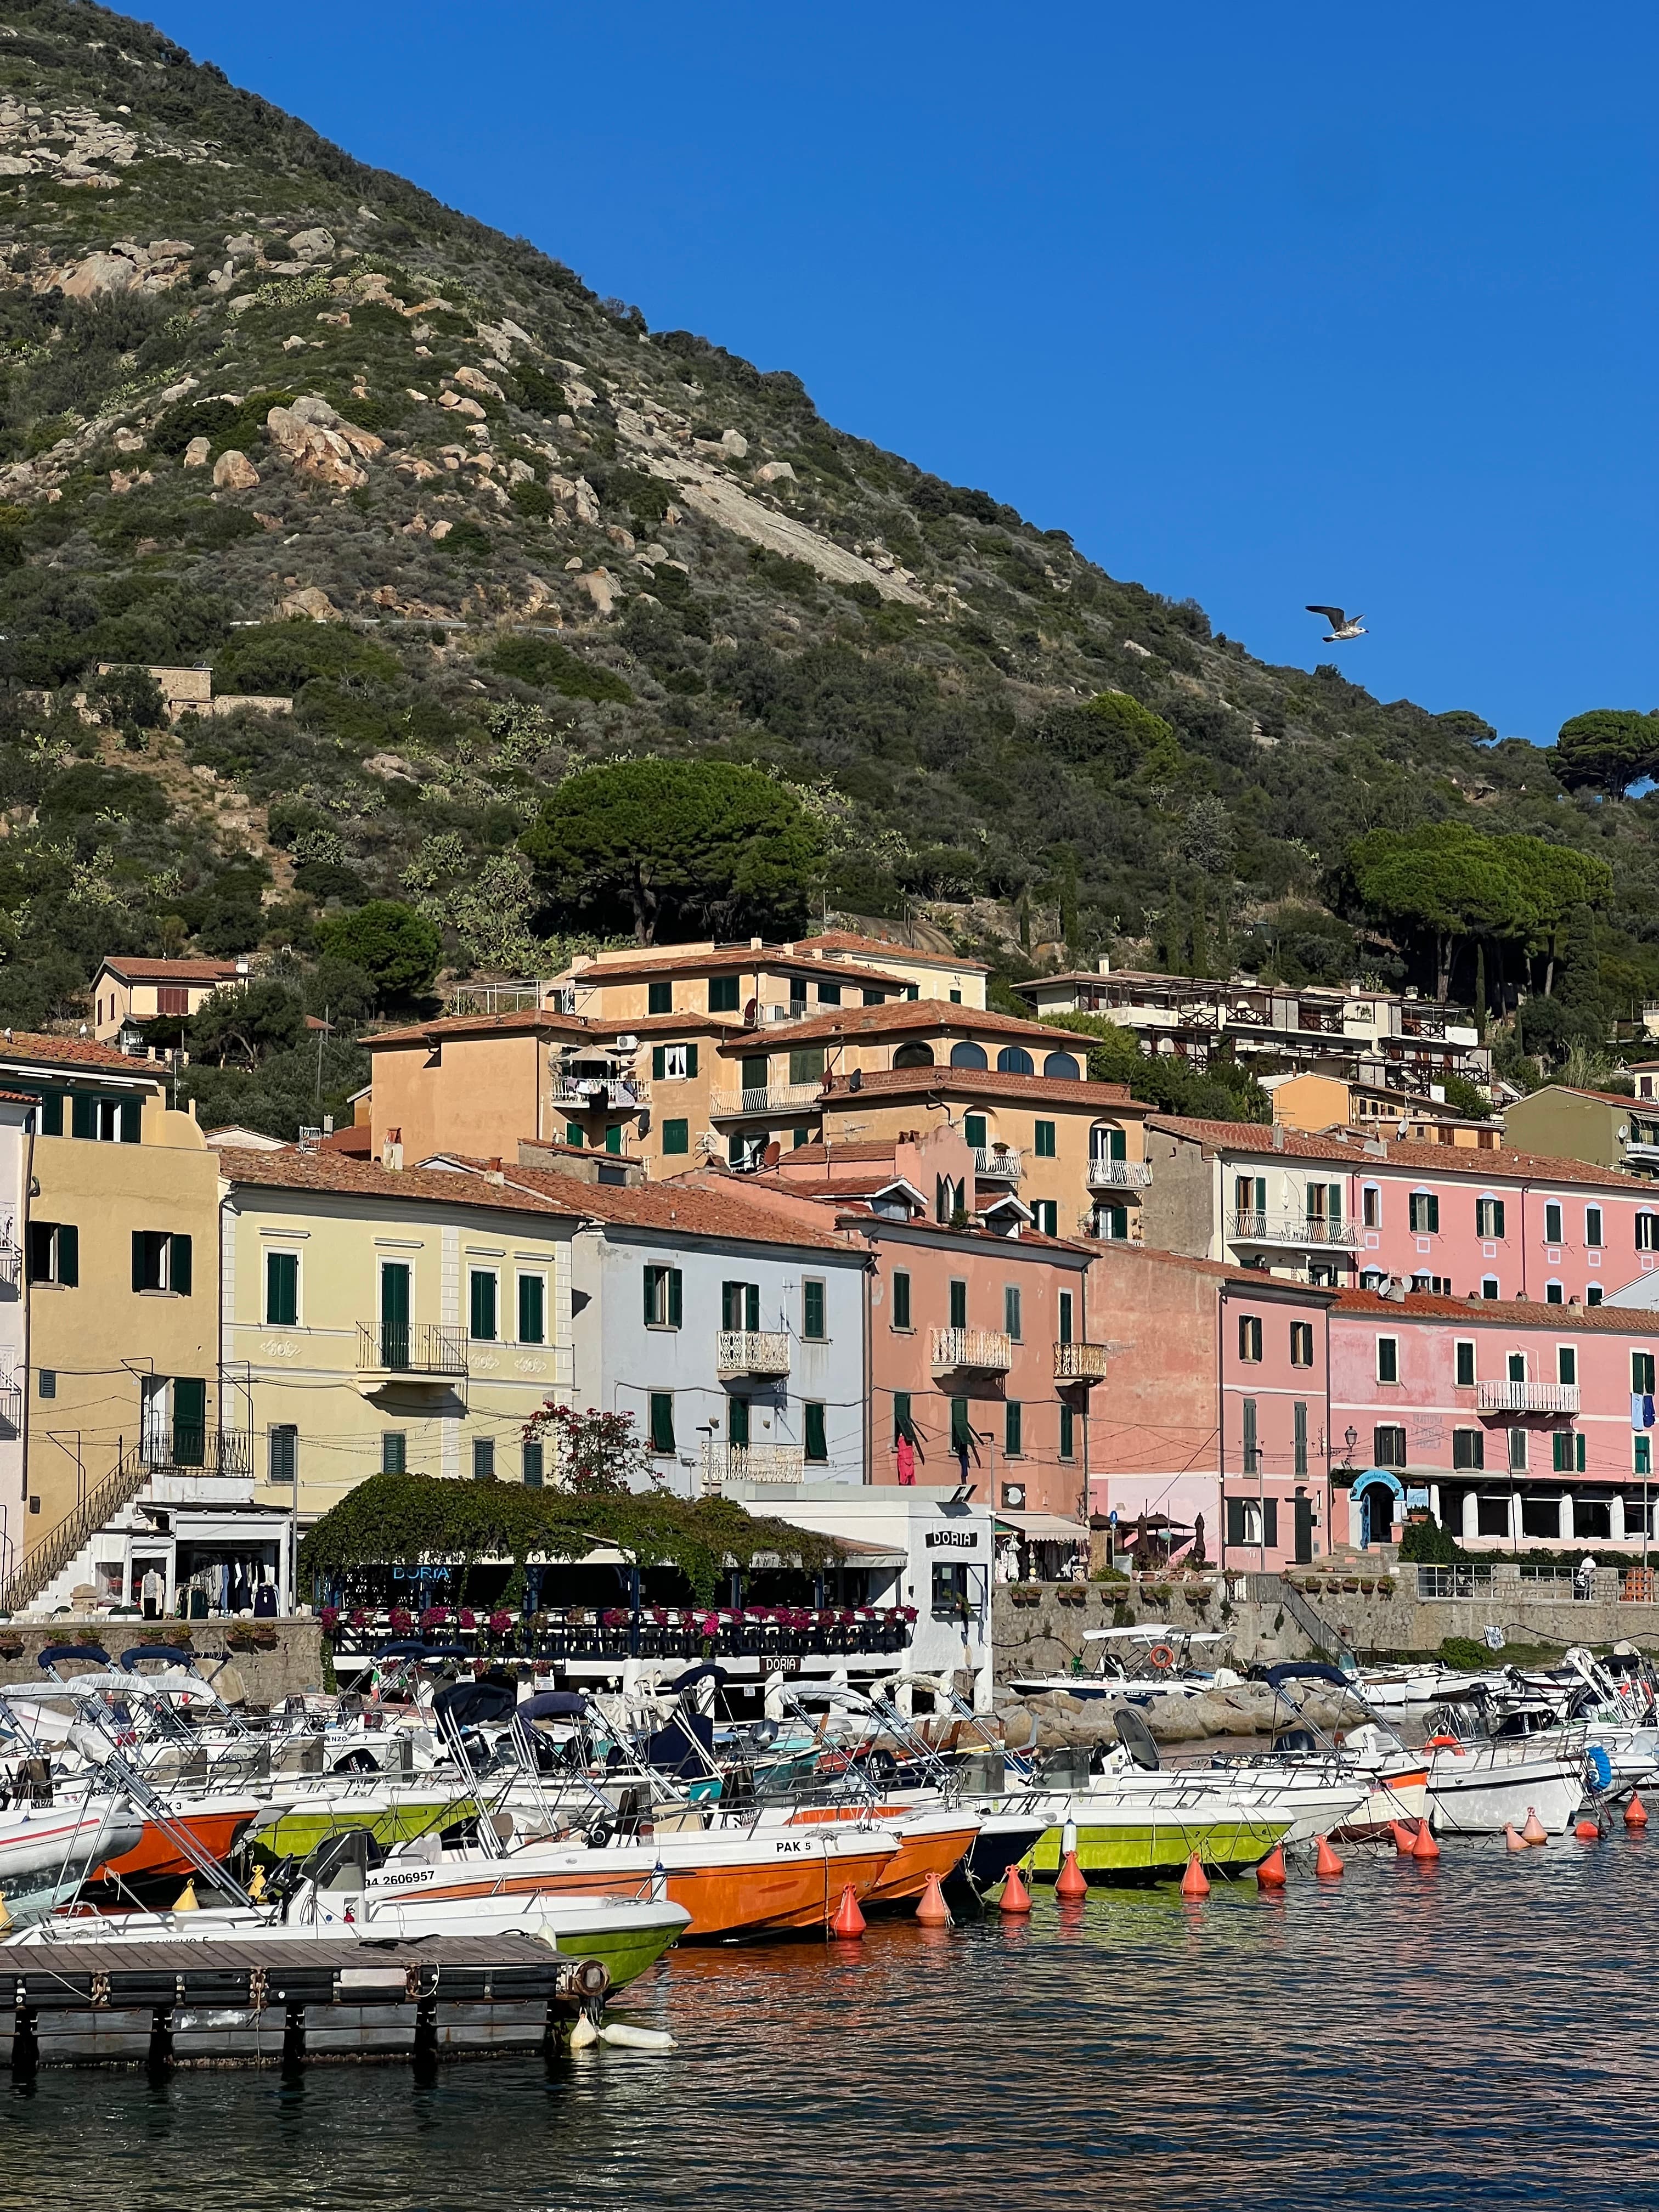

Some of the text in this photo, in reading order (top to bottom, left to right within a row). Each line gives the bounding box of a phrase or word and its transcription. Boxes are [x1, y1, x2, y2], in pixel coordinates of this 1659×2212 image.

[934, 1532, 970, 1545] DORIA
[393, 1567, 450, 1579] DORIA
[766, 1658, 796, 1671] DORIA
[776, 1842, 811, 1852] PAK 5
[383, 1871, 435, 1884] 2606957
